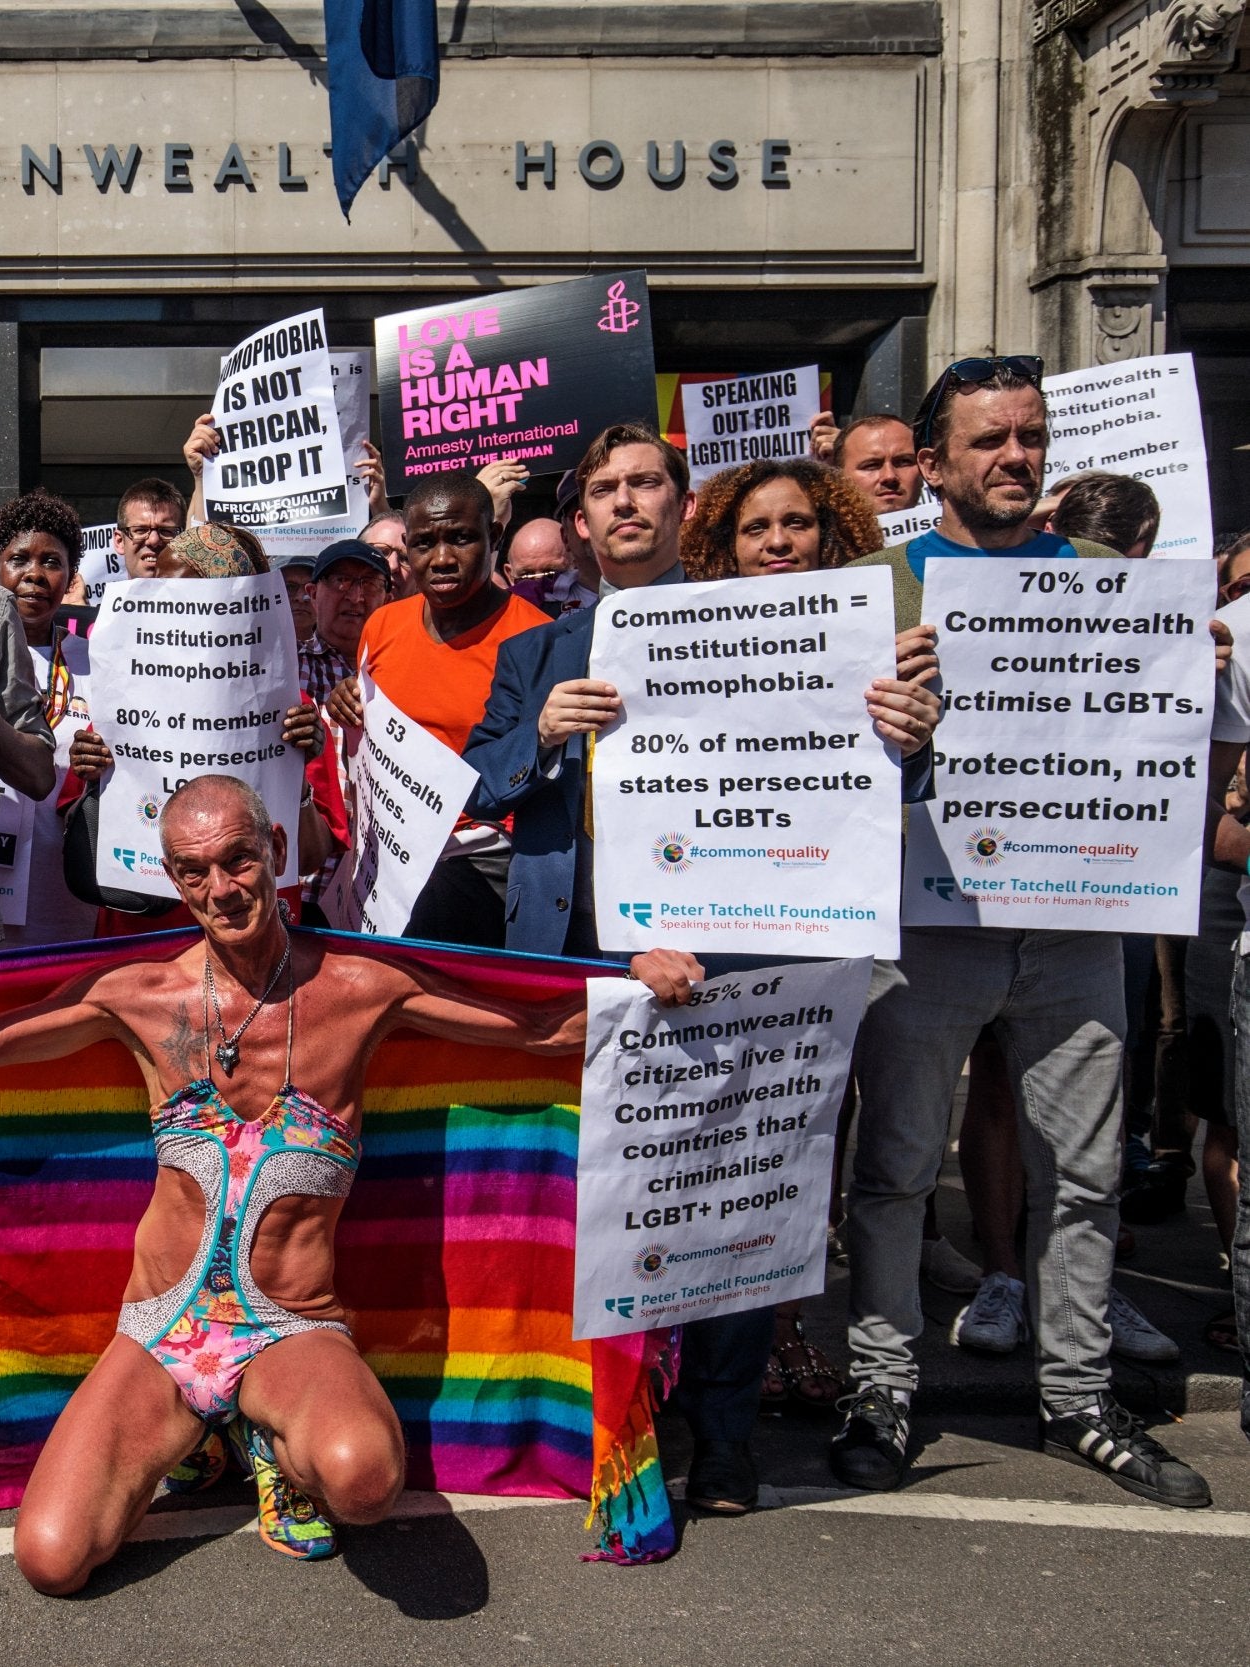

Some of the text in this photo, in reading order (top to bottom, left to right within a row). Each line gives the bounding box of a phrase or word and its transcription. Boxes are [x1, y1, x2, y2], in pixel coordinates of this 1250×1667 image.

[515, 138, 792, 189] HOUSE
[398, 307, 500, 350] LOVE
[399, 343, 474, 379] IS A
[223, 366, 302, 414] IS NOT
[401, 357, 549, 409] HUMAN
[702, 372, 797, 408] SPEAKING
[214, 404, 327, 454] AFRICAN,
[402, 393, 523, 440] RIGHT
[712, 404, 790, 435] OUT FOR
[405, 420, 579, 461] Amnesty International
[691, 440, 736, 466] LGBTI
[221, 445, 323, 490] DROP IT
[405, 457, 468, 477] PROTECT
[214, 501, 272, 515] AFRICAN
[233, 504, 320, 524] FOUNDATION
[1019, 571, 1128, 594] 70% of
[111, 593, 271, 617] Commonwealth
[611, 593, 839, 629] Commonwealth
[136, 626, 262, 648] institutional
[945, 611, 1195, 635] Commonwealth
[648, 631, 827, 662] institutional
[131, 657, 267, 684] homophobia.
[991, 652, 1141, 674] countries
[646, 671, 835, 699] homophobia.
[1084, 691, 1204, 714] LGBTs.
[116, 705, 281, 731] 80% of member
[385, 717, 406, 743] 53
[114, 740, 287, 769] states persecute
[631, 730, 860, 754] 80% of member
[933, 751, 1196, 783] Protection, not
[619, 769, 872, 796] states persecute
[694, 808, 792, 828] LGBTs
[942, 798, 1170, 824] persecution!
[690, 844, 830, 862] #commonequality
[1003, 841, 1139, 858] #commonequality
[963, 877, 1179, 896] Peter Tatchell Foundation
[660, 902, 876, 921] Peter Tatchell Foundation
[660, 920, 830, 934] Speaking Human Rights
[752, 977, 783, 996] of
[619, 1005, 834, 1051] Commonwealth
[624, 1041, 819, 1086] citizens live in
[615, 1074, 821, 1125] Commonwealth
[622, 1110, 808, 1161] countries that
[648, 1151, 784, 1194] criminalise
[624, 1182, 799, 1231] LGBT+ people
[666, 1234, 776, 1265] #commonequality
[641, 1264, 805, 1306] Peter Tatchell Foundation
